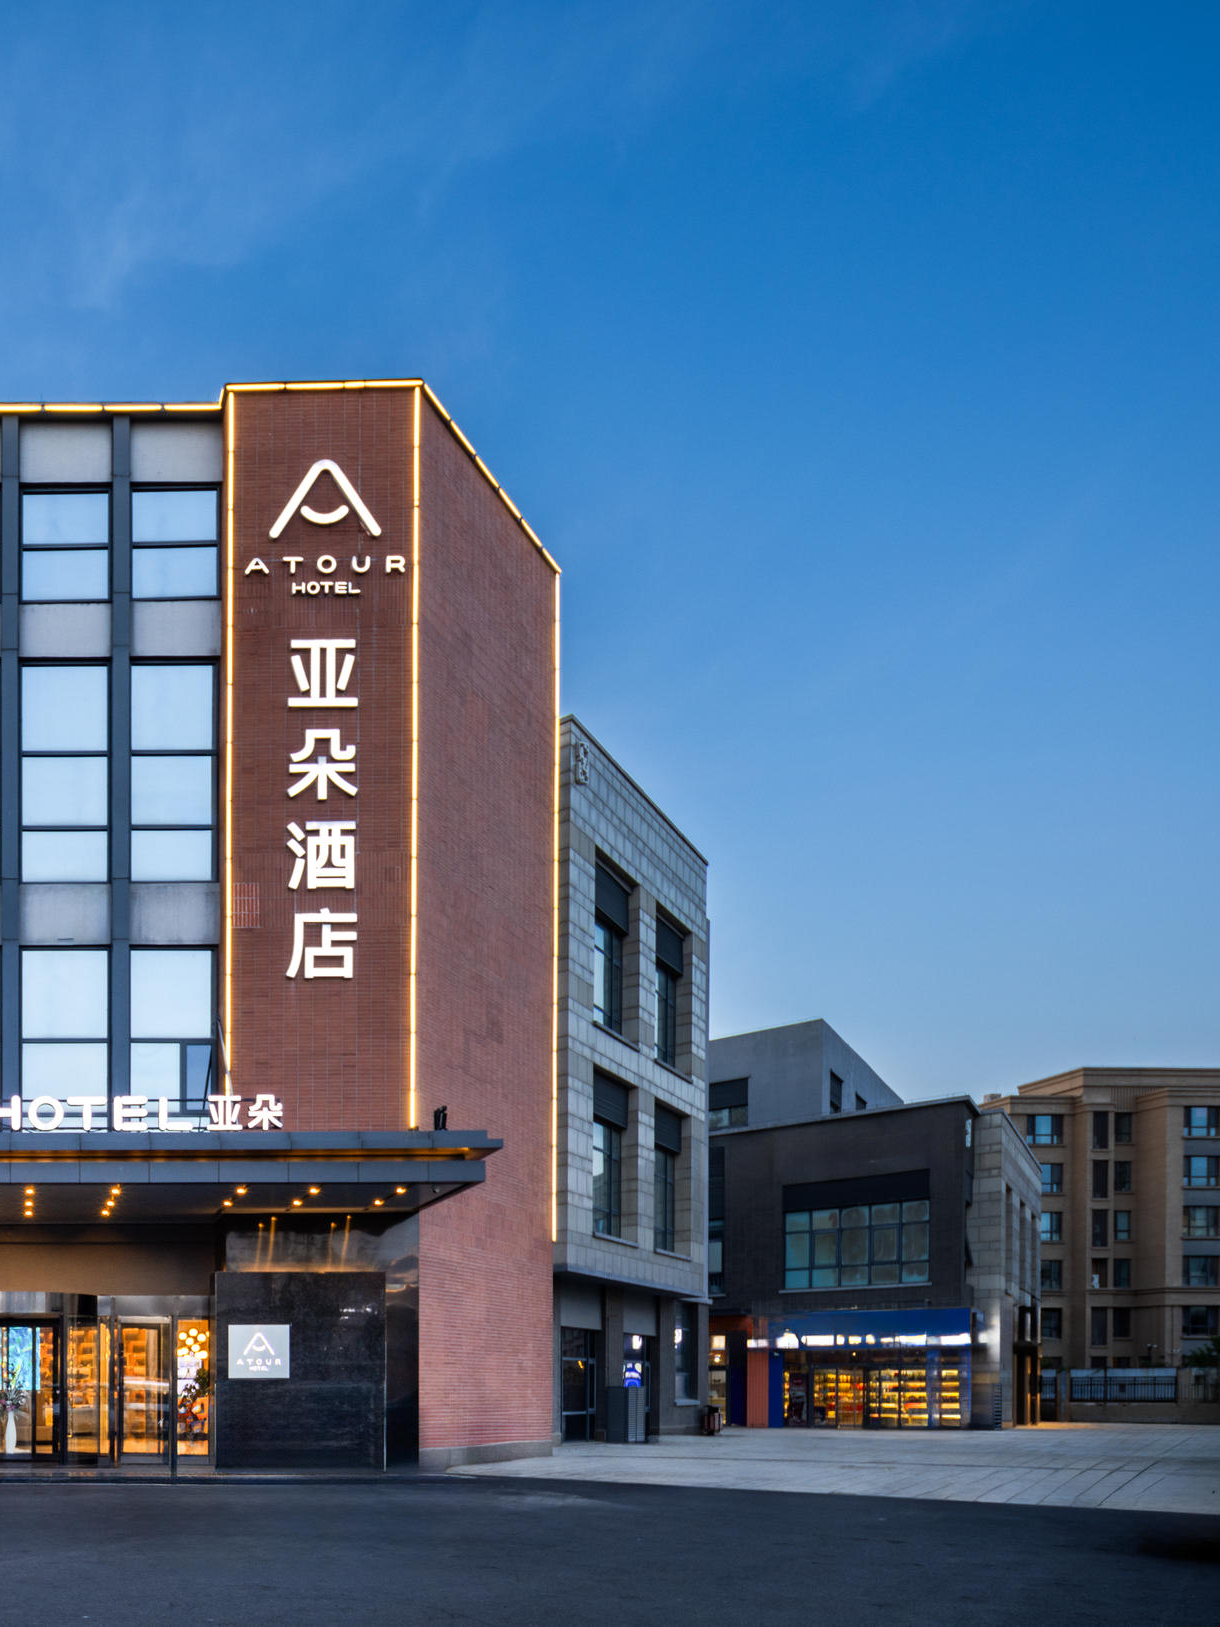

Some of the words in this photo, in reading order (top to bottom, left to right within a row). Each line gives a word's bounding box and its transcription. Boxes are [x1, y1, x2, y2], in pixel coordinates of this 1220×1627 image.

[244, 555, 406, 575] ATOUR
[292, 581, 361, 595] HOTEL
[286, 639, 359, 980] 亚朵酒店
[207, 1094, 283, 1131] 亚朵
[236, 1358, 282, 1366] ATOUR
